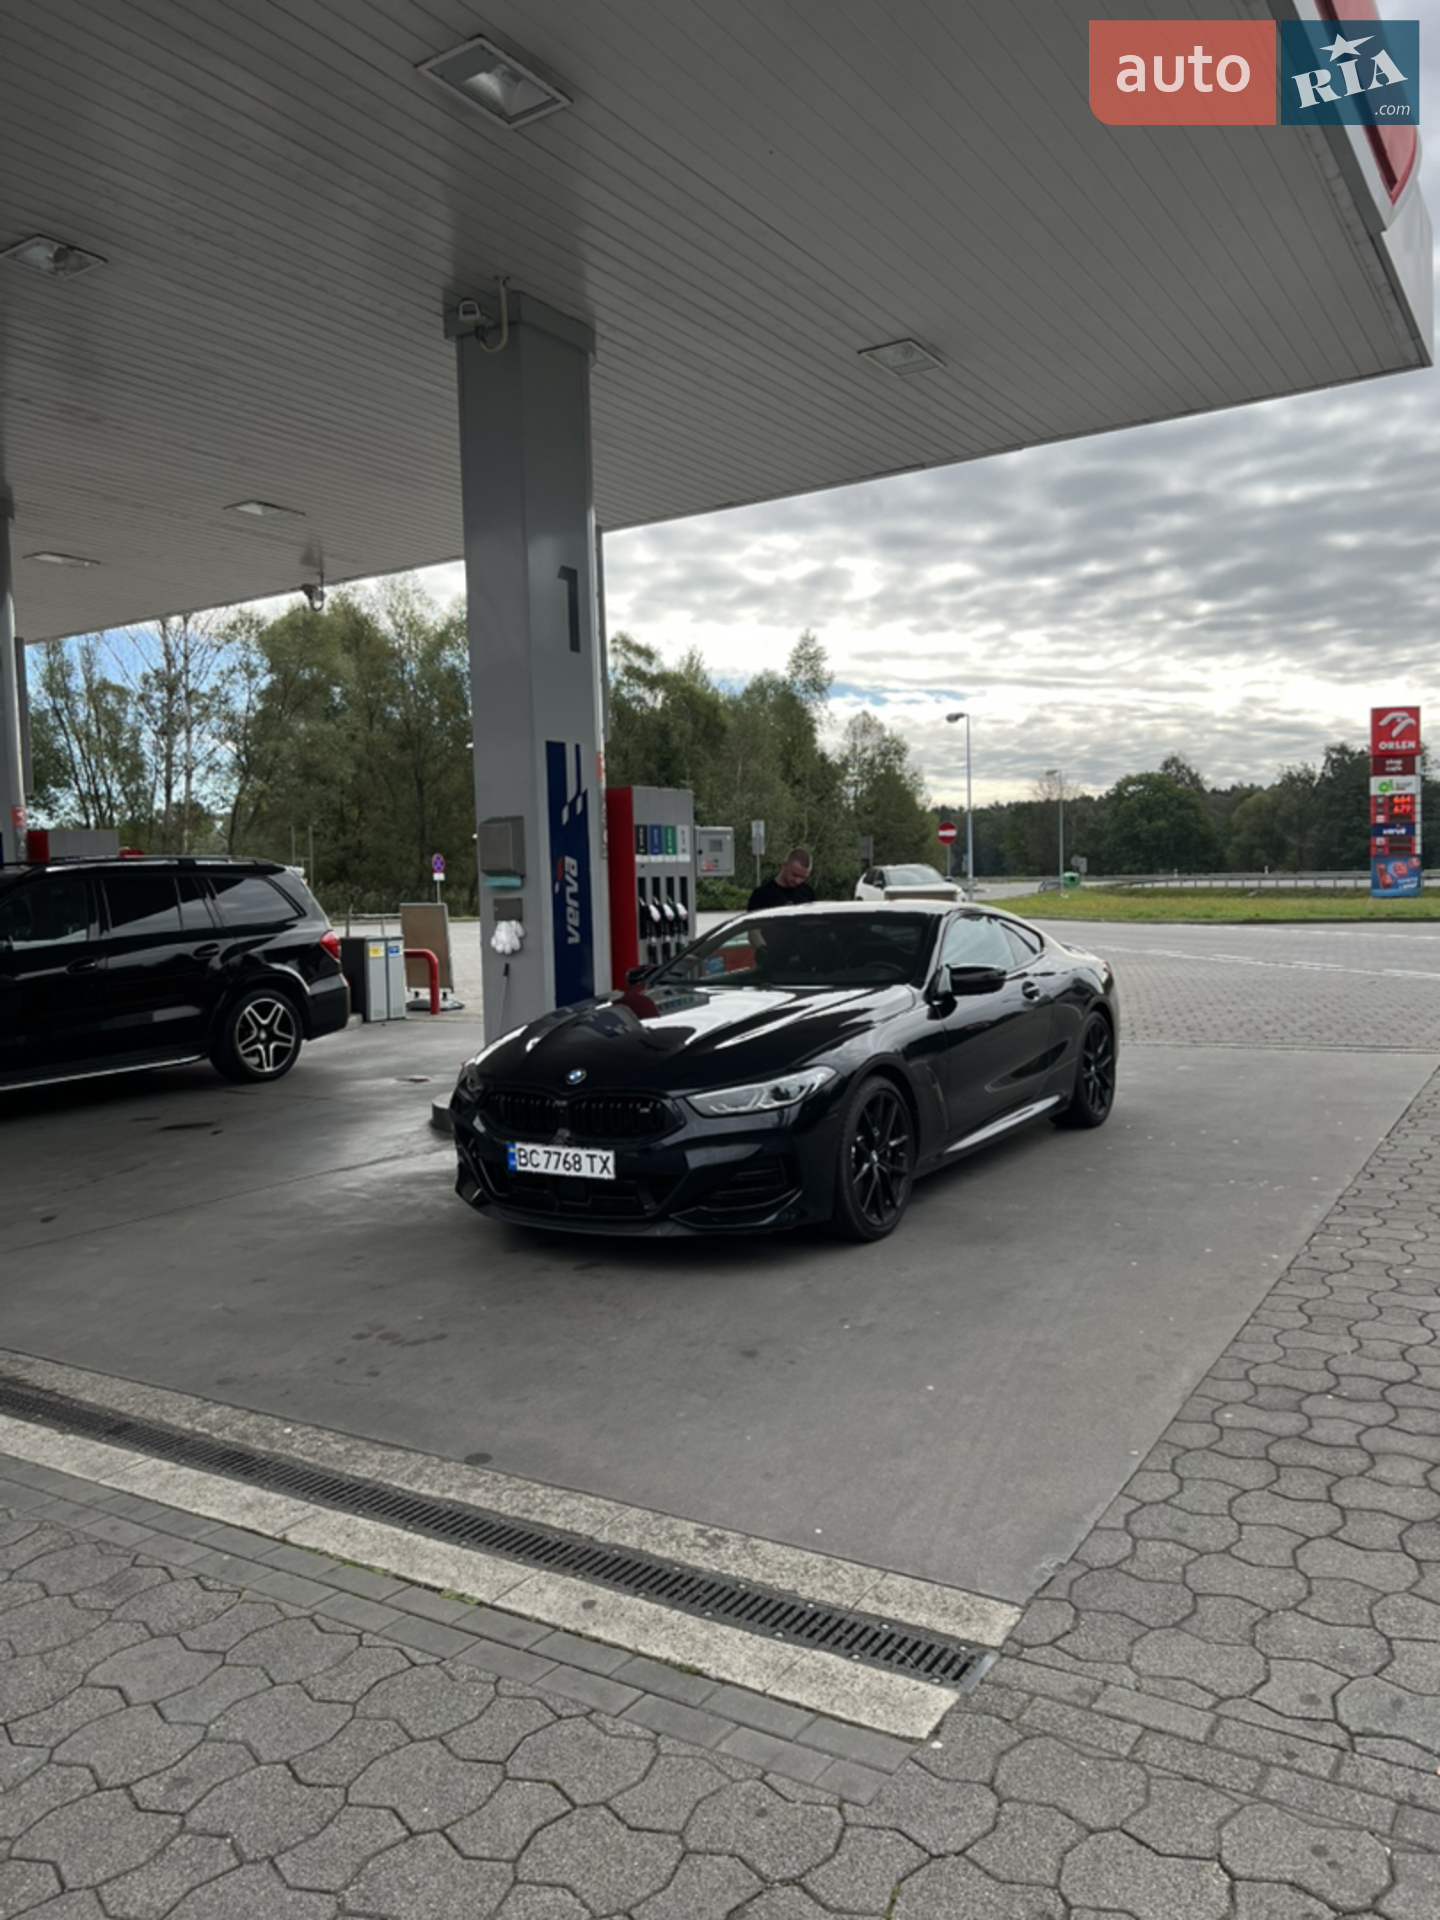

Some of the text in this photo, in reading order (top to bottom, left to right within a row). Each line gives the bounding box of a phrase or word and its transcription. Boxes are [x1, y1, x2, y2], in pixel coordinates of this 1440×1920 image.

[557, 564, 581, 654] 1
[1378, 741, 1416, 750] ORLEN
[563, 855, 581, 945] verva
[518, 1147, 612, 1175] BC 7768 TX
